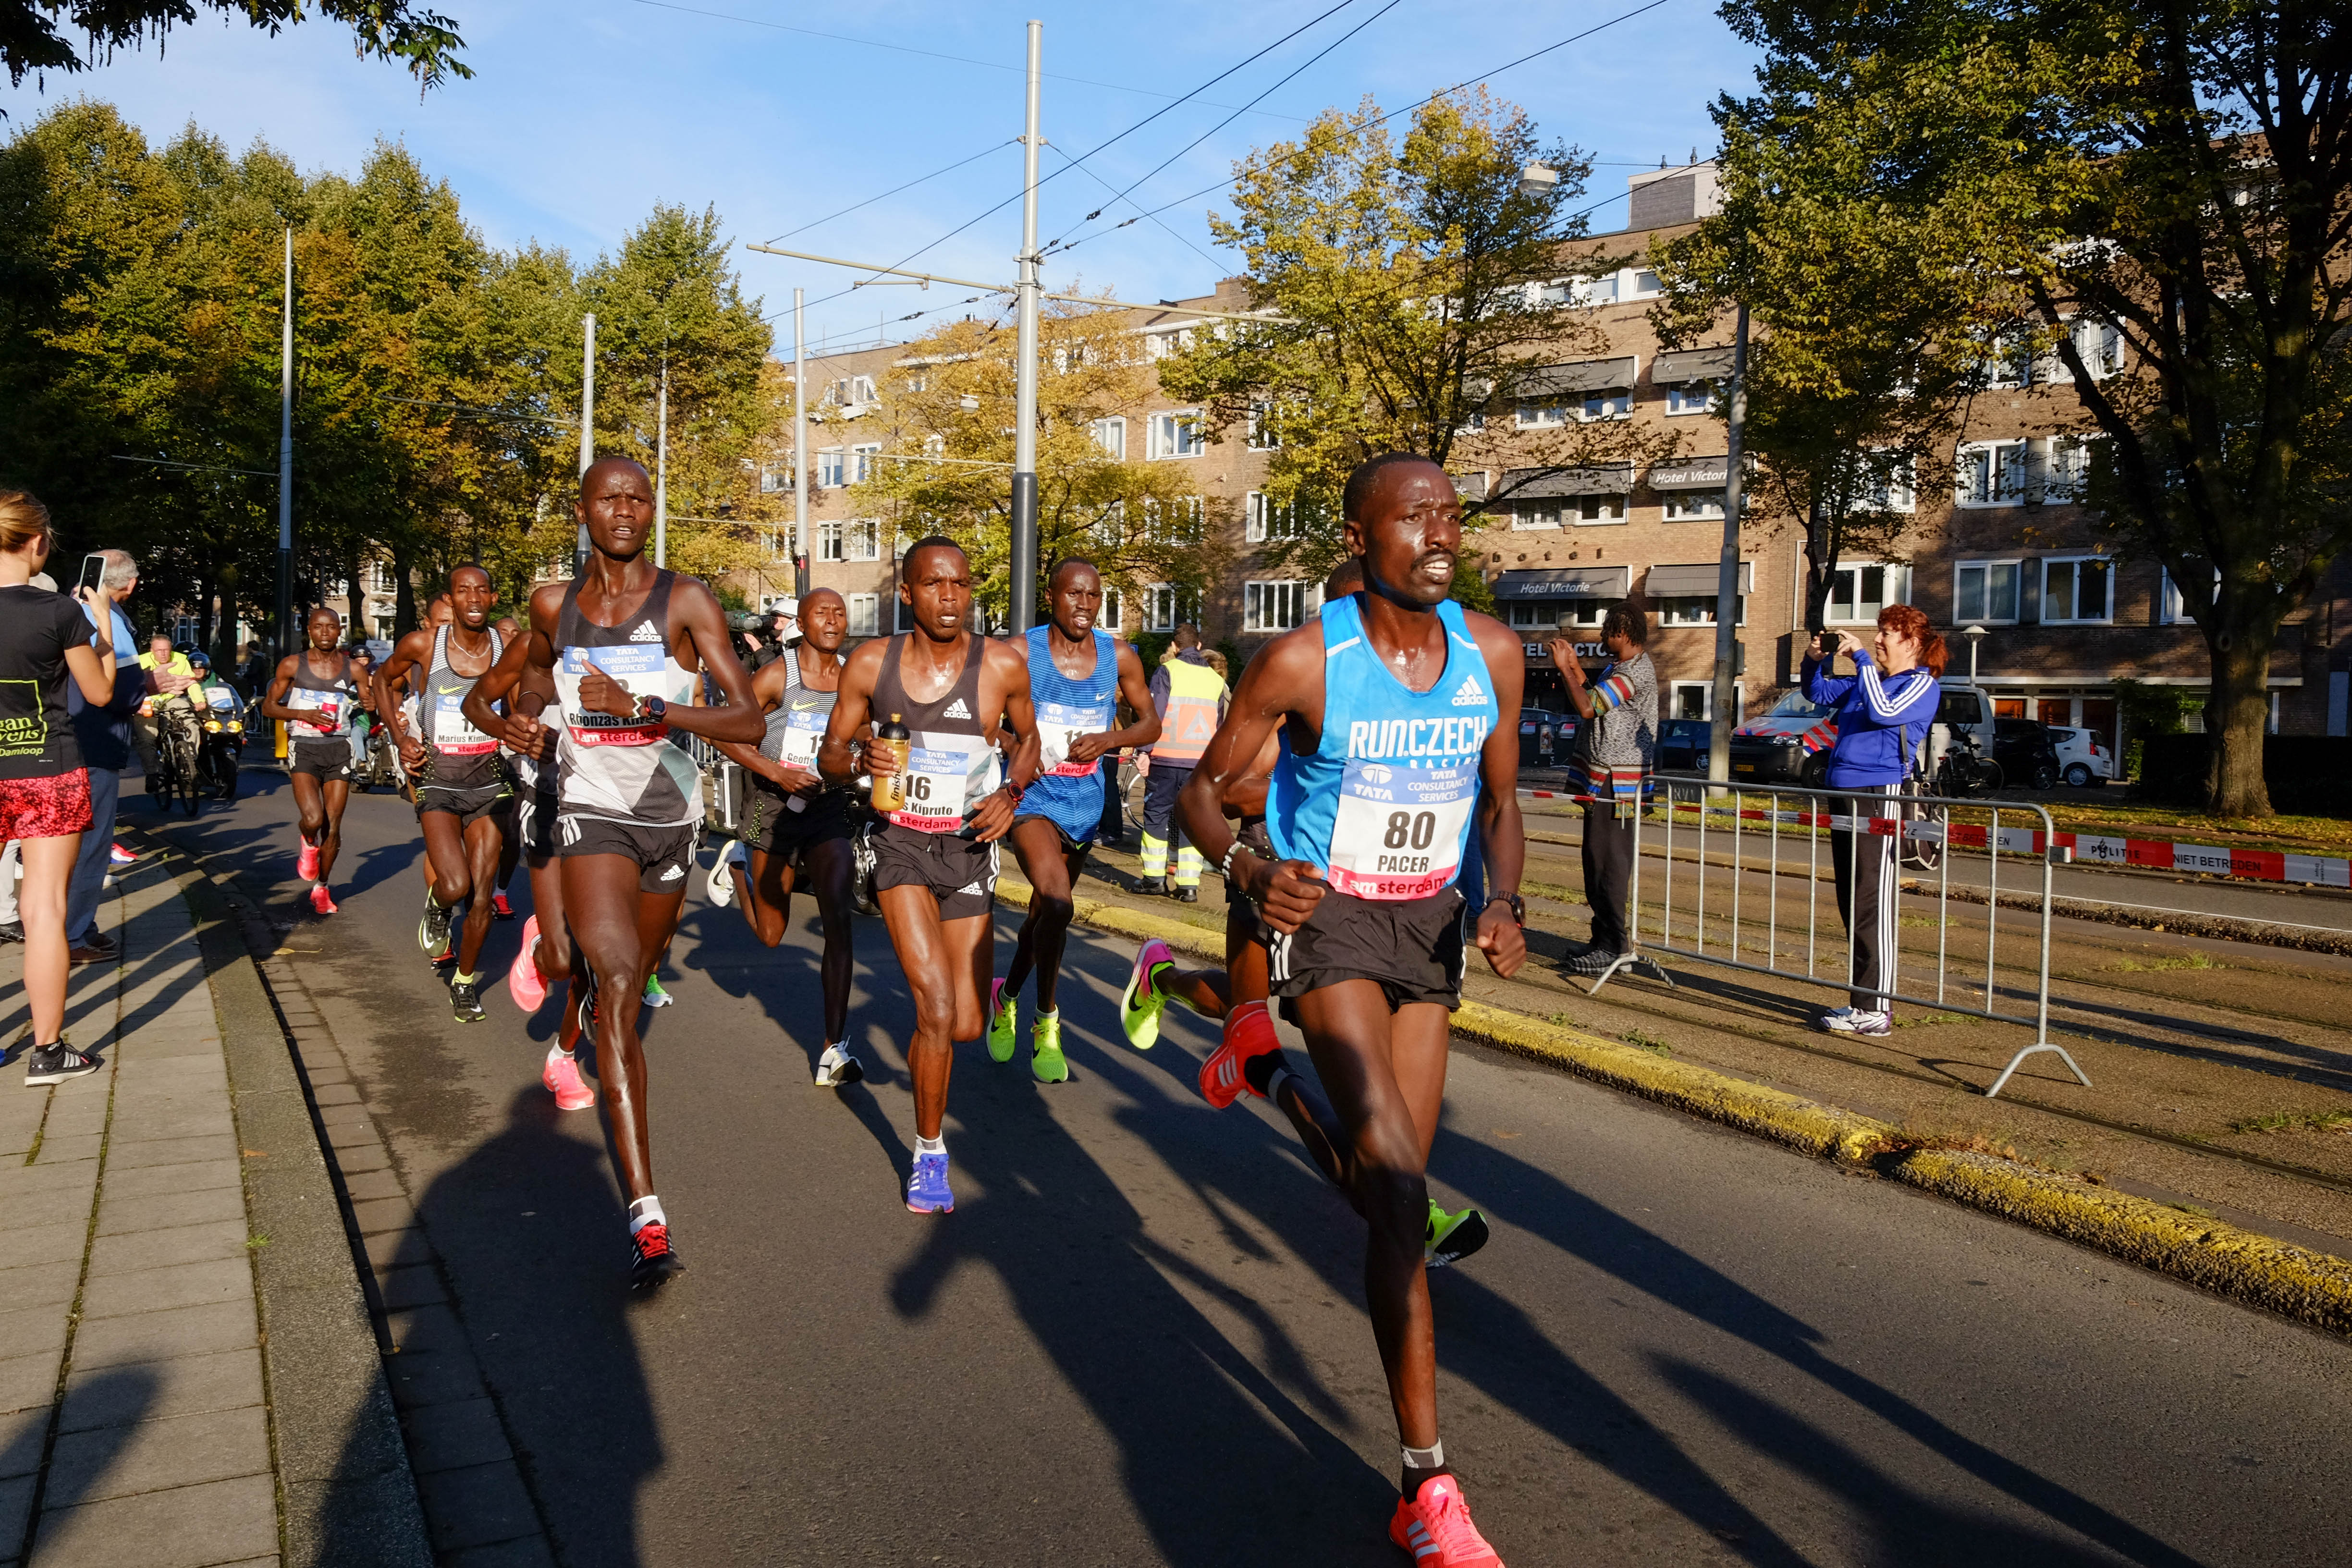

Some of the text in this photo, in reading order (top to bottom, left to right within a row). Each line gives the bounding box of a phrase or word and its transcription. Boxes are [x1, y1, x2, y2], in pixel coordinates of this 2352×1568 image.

[1656, 469, 1728, 483] Hotel Victori
[1520, 582, 1590, 593] Hotel Victorie
[630, 633, 662, 642] adidas
[600, 655, 655, 665] CONSULTANCY
[569, 664, 588, 673] TAT
[611, 664, 646, 673] SERVICES
[1451, 693, 1488, 706] adidas
[943, 710, 971, 720] adidas
[1044, 715, 1063, 723] TATA
[912, 757, 960, 766] CONSULTANCY
[919, 764, 951, 773] SERVICES
[1431, 770, 1457, 780] TATA
[906, 774, 931, 801] 16
[1407, 776, 1469, 791] CONSULTANCY
[1354, 783, 1393, 801] TATA
[1418, 790, 1458, 802] SERVICES
[911, 802, 953, 816] Kipruto
[1384, 811, 1436, 850] 80
[1962, 833, 2010, 846] BETREEN
[1377, 855, 1430, 872] PACER
[2173, 854, 2261, 871] NIET BETREDEN
[1335, 870, 1345, 887] I
